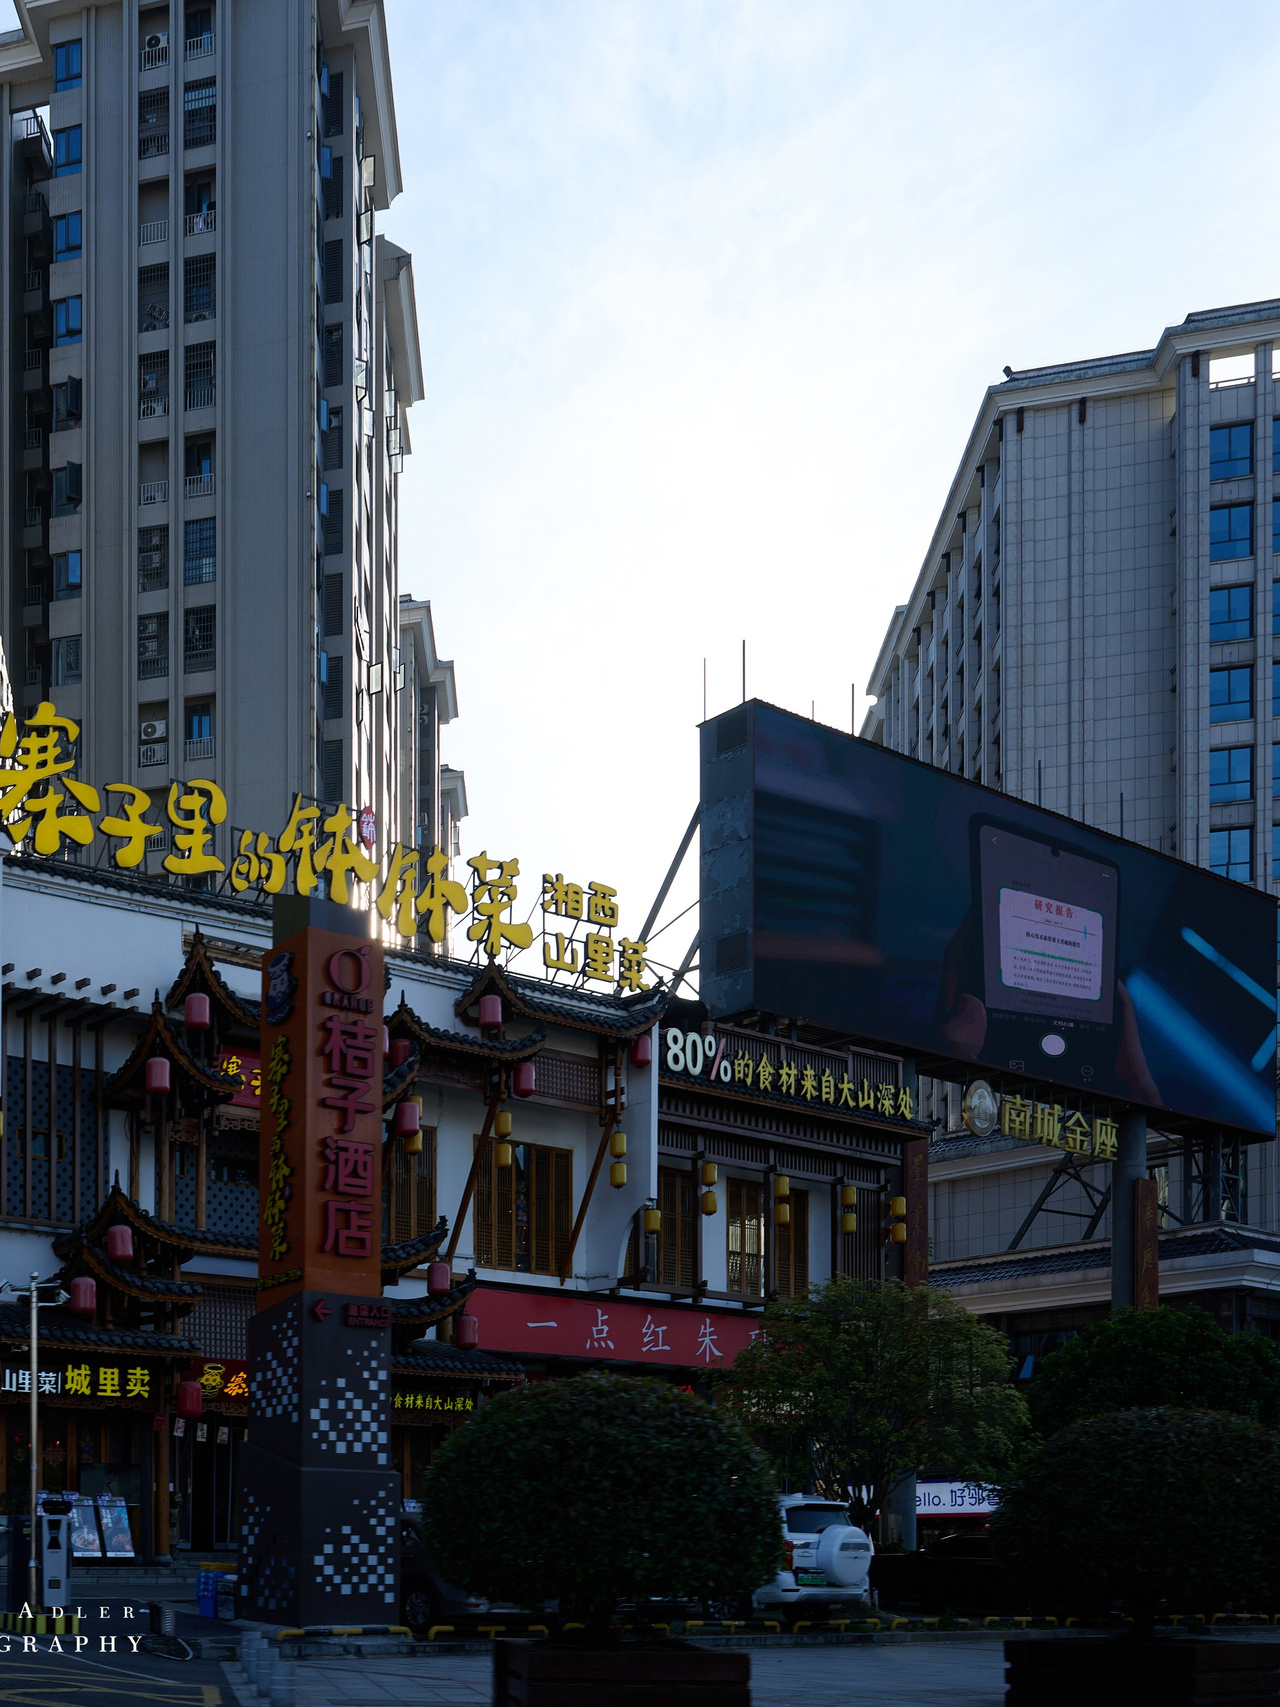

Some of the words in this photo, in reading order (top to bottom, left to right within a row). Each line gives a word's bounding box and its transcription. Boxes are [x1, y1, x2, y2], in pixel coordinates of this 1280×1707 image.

[542, 872, 619, 928] 湘西
[1034, 899, 1074, 919] 研究报告
[544, 932, 650, 992] 山里菜
[665, 1026, 914, 1122] 80%的食材来自大山深处
[321, 1014, 376, 1259] 桔子酒店
[1000, 1094, 1120, 1162] 南城金座
[348, 1316, 390, 1327] ENTRANCE
[0, 1368, 58, 1395] 山里菜
[64, 1363, 151, 1399] 城里卖
[223, 1371, 249, 1397] 寨
[389, 1391, 474, 1412] 食材来自大山深处
